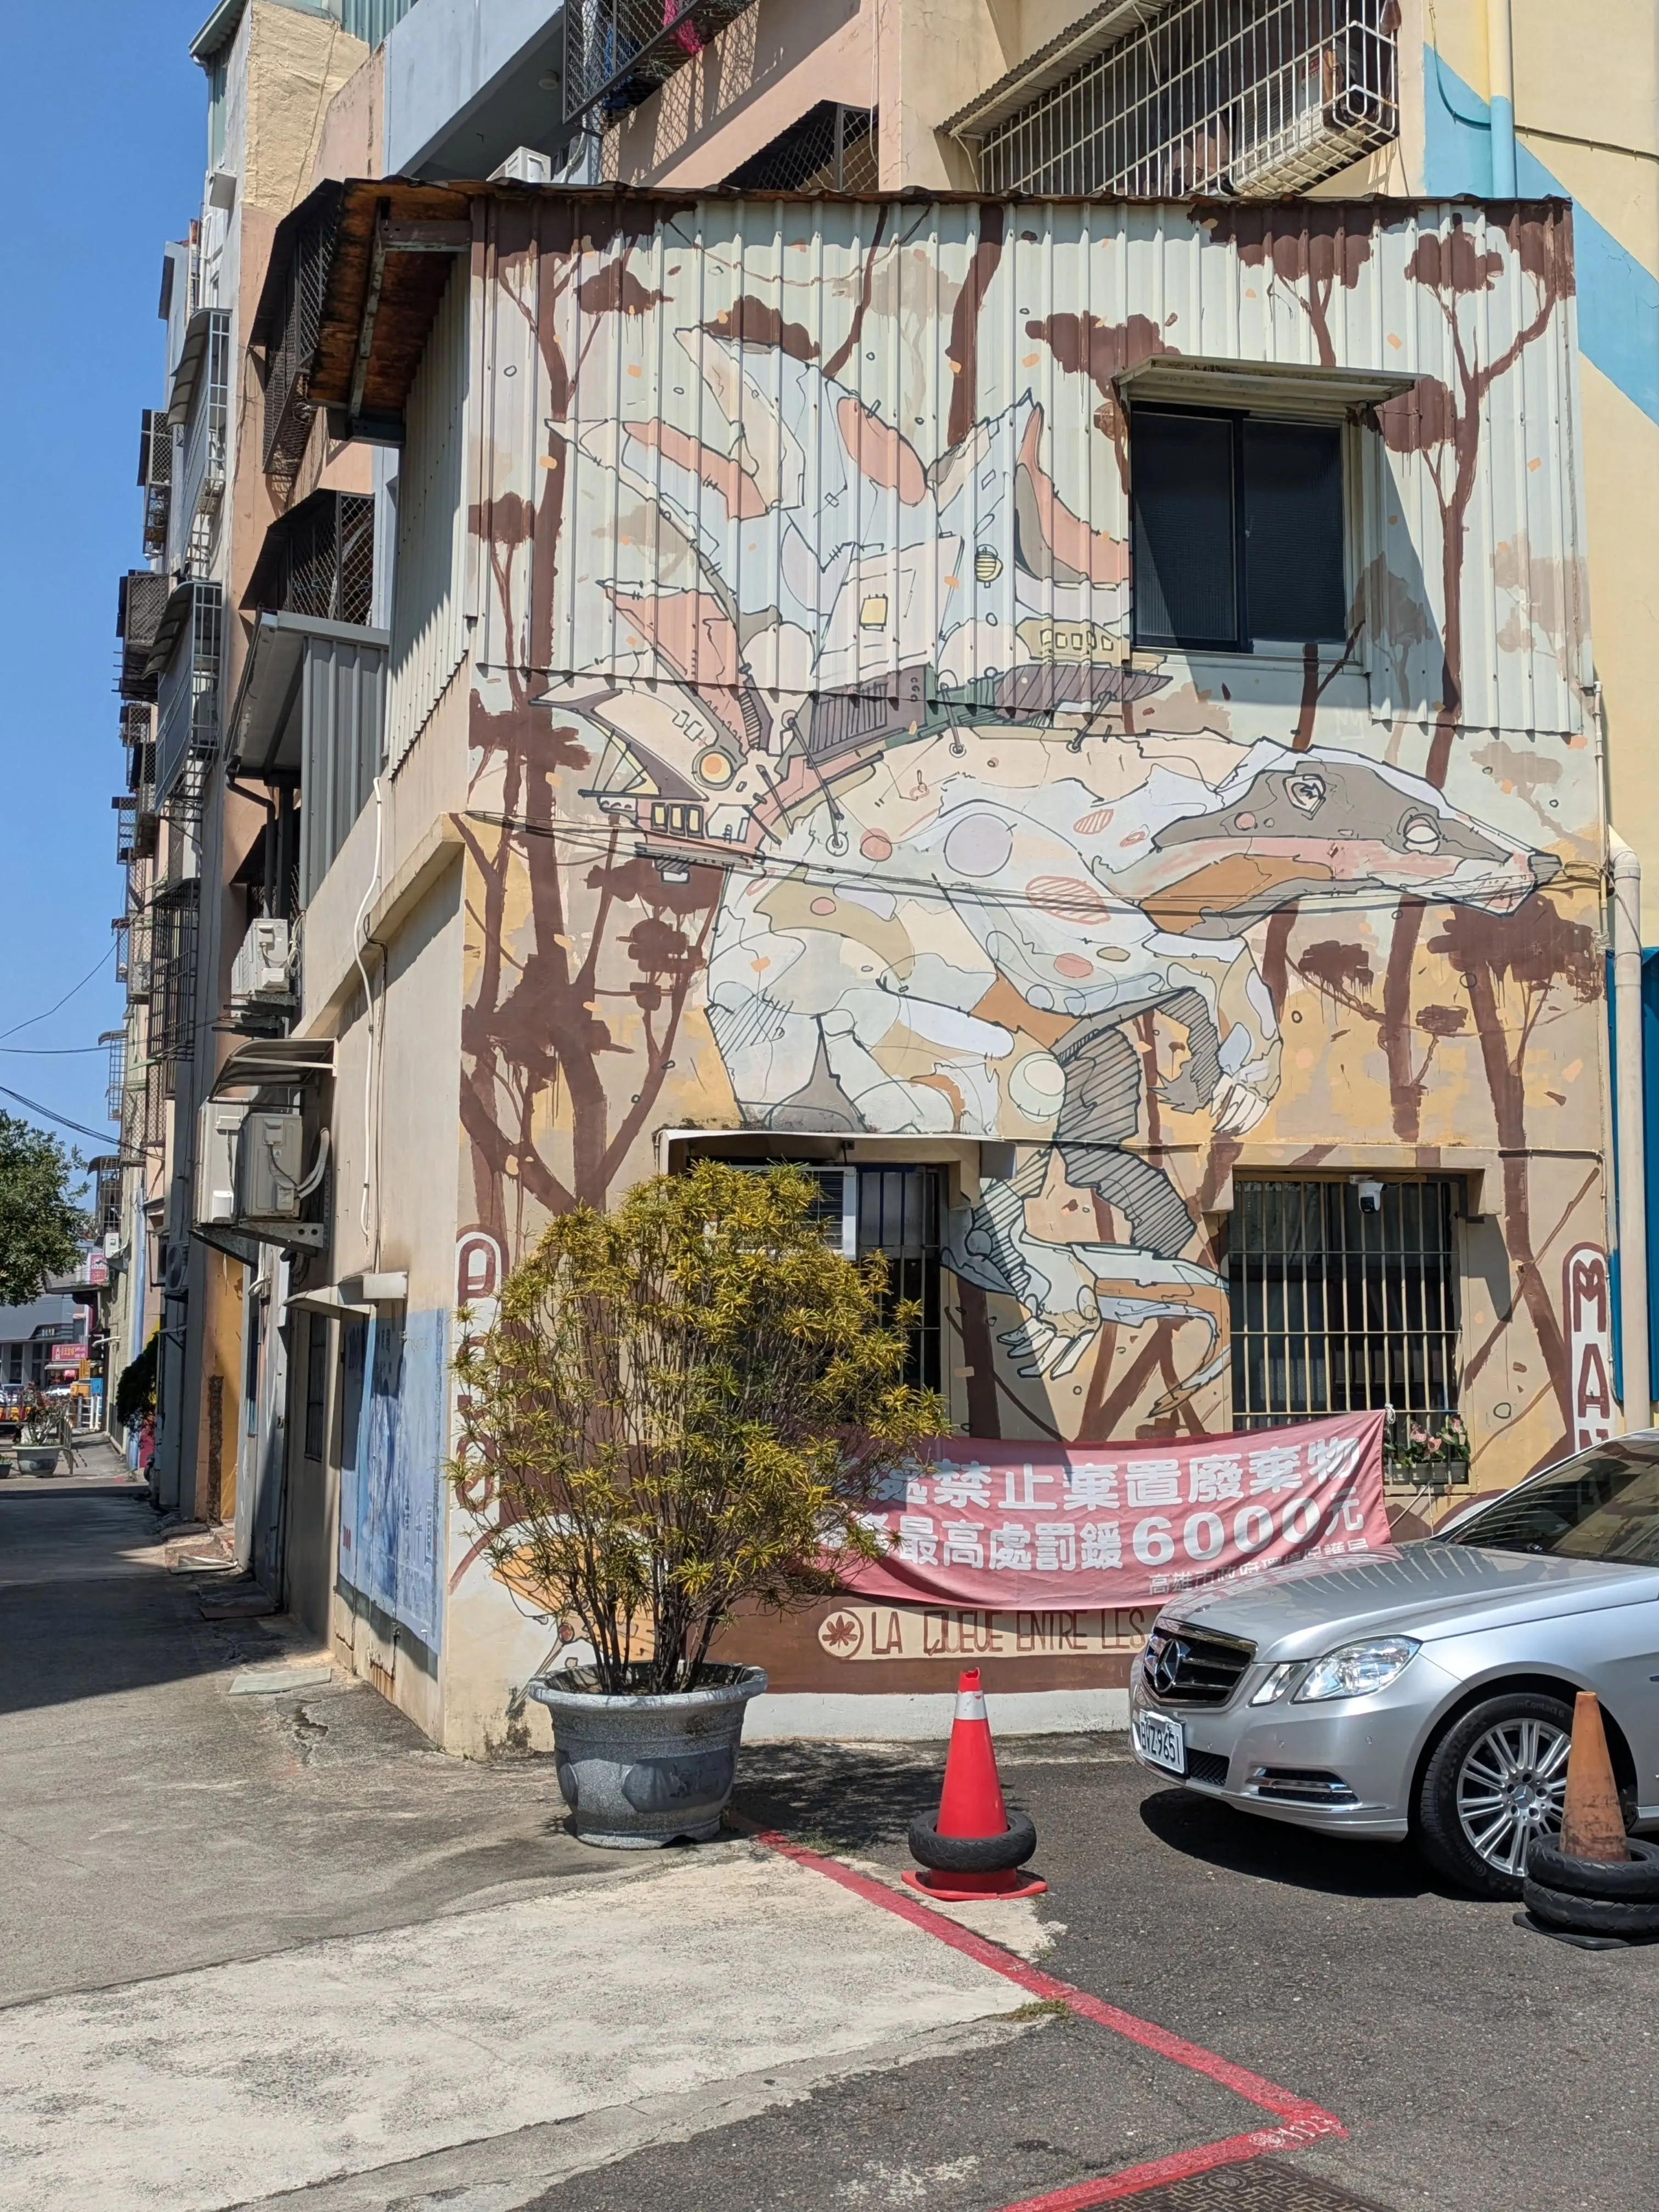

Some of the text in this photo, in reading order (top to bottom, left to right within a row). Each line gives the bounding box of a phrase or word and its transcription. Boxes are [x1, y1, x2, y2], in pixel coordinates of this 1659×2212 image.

[832, 1436, 1360, 1511] 處禁止棄置廢棄物
[871, 1607, 1146, 1656] LA QUEUE ENTRE LES
